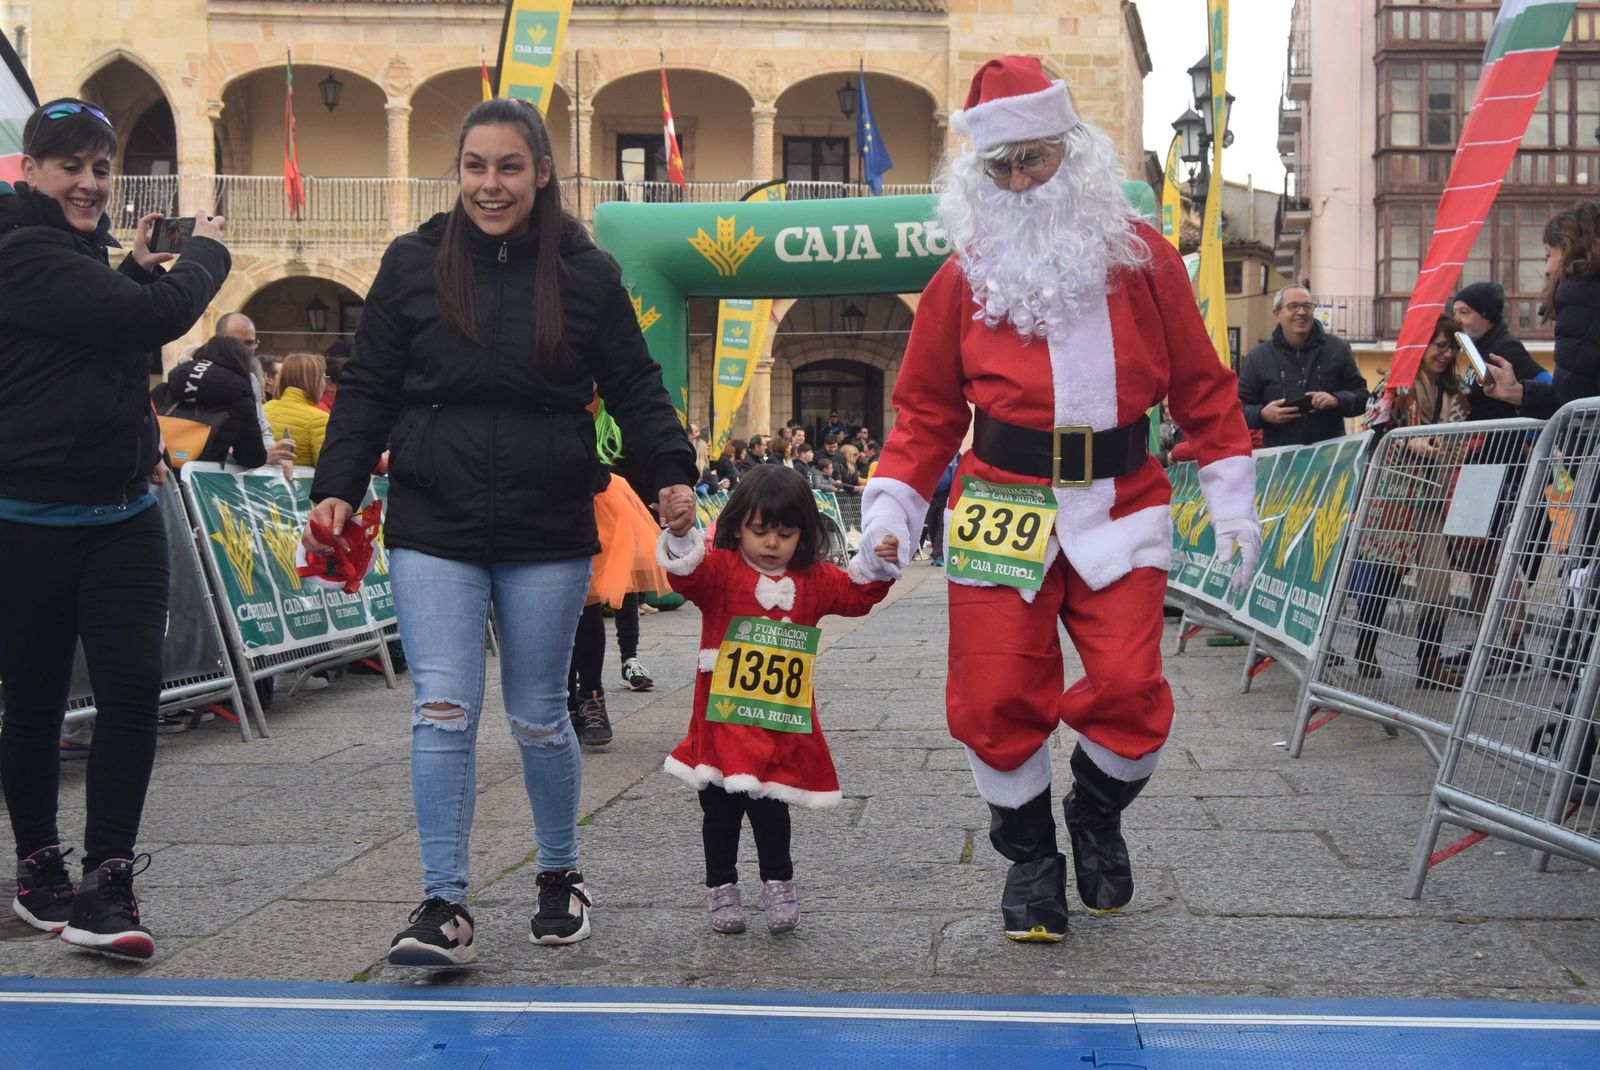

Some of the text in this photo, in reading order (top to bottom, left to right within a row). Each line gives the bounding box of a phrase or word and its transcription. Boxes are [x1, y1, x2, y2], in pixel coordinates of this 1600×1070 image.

[774, 225, 882, 263] CAJA
[987, 484, 1044, 499] FUNDACION
[992, 491, 1014, 502] CAJA
[957, 504, 1042, 552] 339
[970, 559, 993, 573] CAJA
[754, 623, 809, 641] FUNDACION
[753, 633, 779, 647] CAJA
[779, 637, 807, 650] RURAL
[727, 647, 804, 699] 1358
[737, 705, 806, 726] CAJA RURAL
